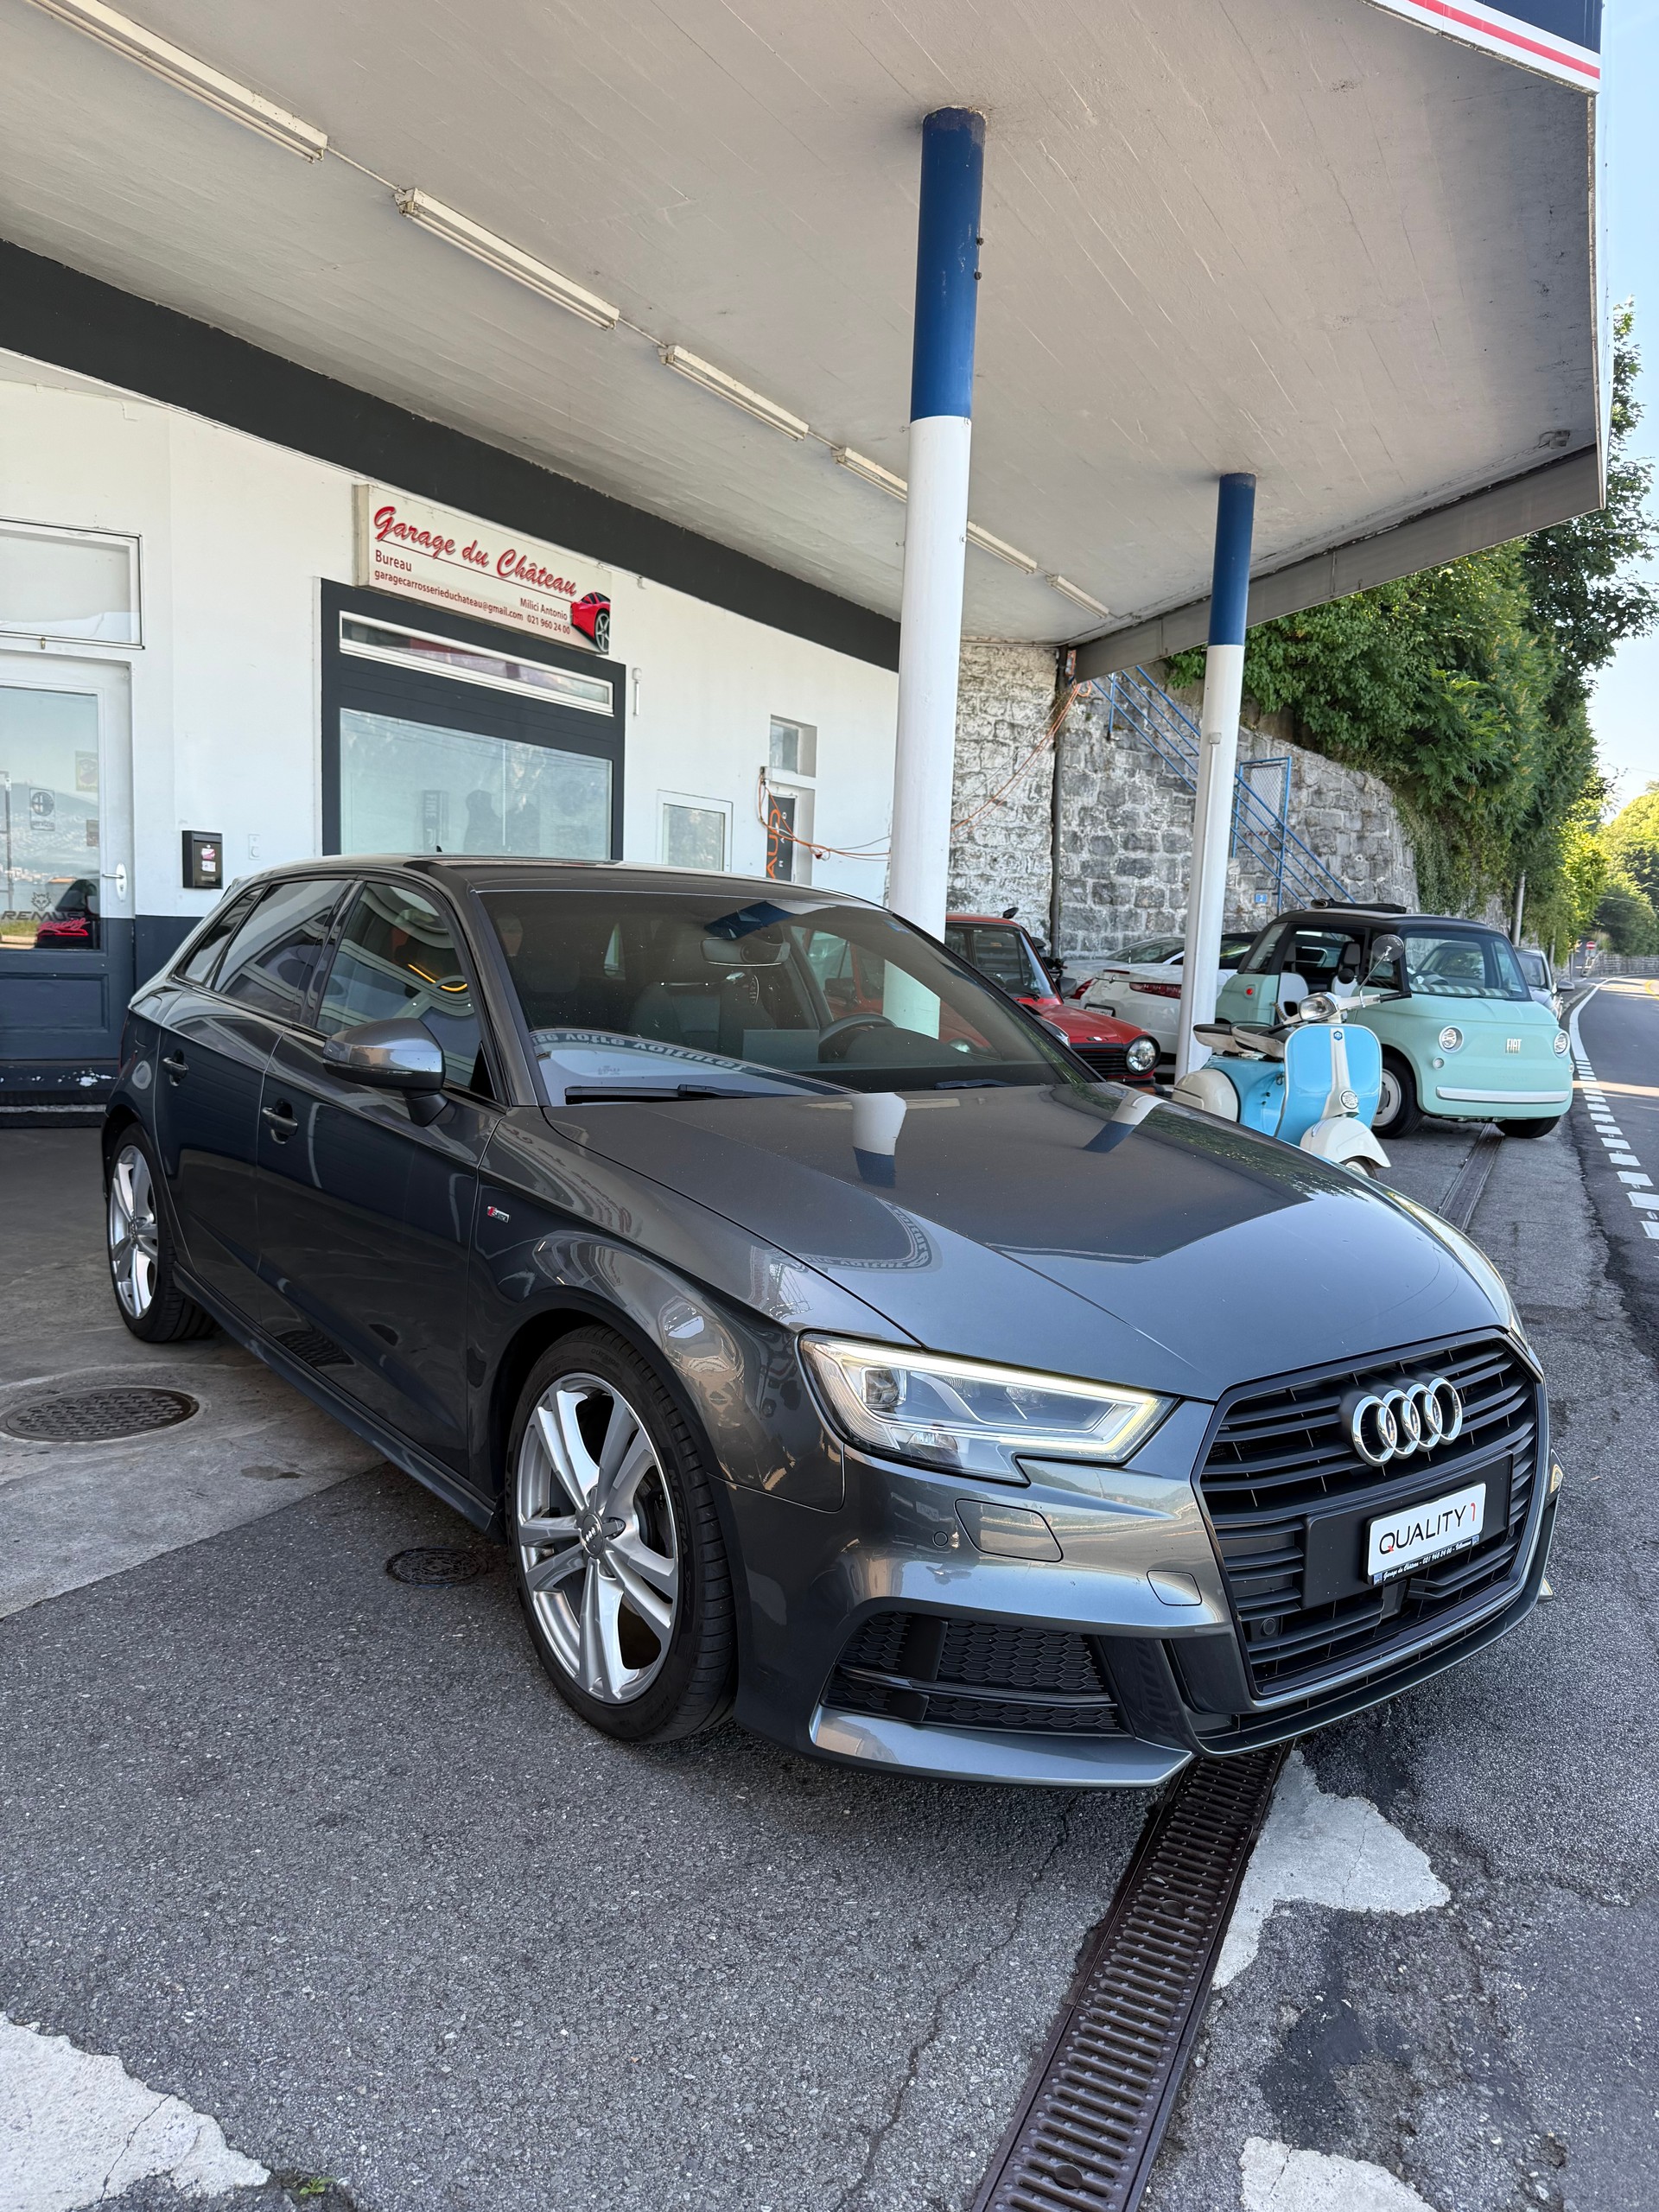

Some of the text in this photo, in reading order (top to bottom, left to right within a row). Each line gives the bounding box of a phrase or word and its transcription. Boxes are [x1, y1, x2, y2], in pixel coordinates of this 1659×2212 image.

[374, 506, 577, 596] Garage du Château
[375, 550, 412, 572] Bureau
[374, 570, 571, 635] garagecarrosserieduchateau@gmail.com 021 960 24 00
[520, 598, 569, 620] Milici Antonio
[1, 910, 86, 923] REMUS
[1506, 1038, 1522, 1053] FIAT
[1379, 1502, 1477, 1555] QUALITY 1
[1382, 1570, 1398, 1581] Garage
